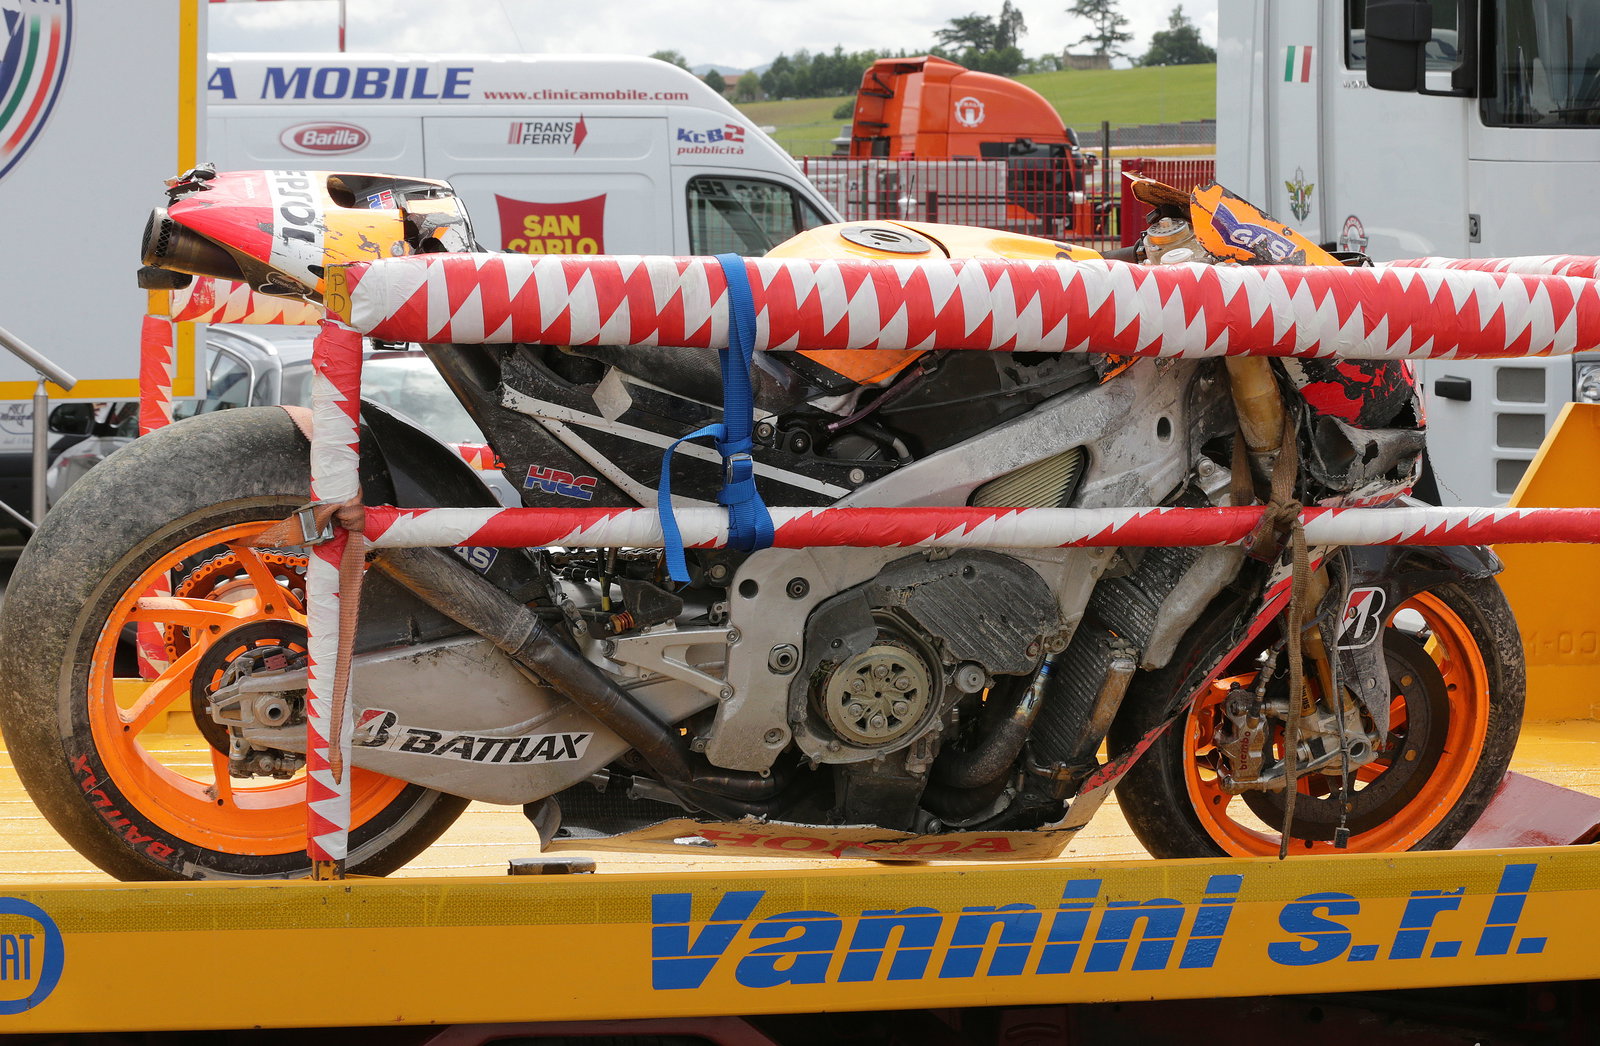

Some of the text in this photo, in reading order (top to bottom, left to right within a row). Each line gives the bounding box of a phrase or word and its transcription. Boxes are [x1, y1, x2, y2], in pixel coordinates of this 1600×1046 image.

[261, 67, 474, 100] MOBILE
[484, 89, 689, 101] www.clinicamobile.com
[302, 129, 360, 146] Barilla
[522, 133, 571, 145] FERRY
[524, 122, 573, 133] TRANS
[677, 146, 745, 155] pubblicità
[523, 214, 580, 238] SAN
[523, 464, 598, 501] HRC
[453, 546, 491, 569] AS
[399, 728, 590, 763] BATTLAX
[1240, 731, 1251, 770] brembo
[652, 863, 1548, 990] Vannini s.r.l.
